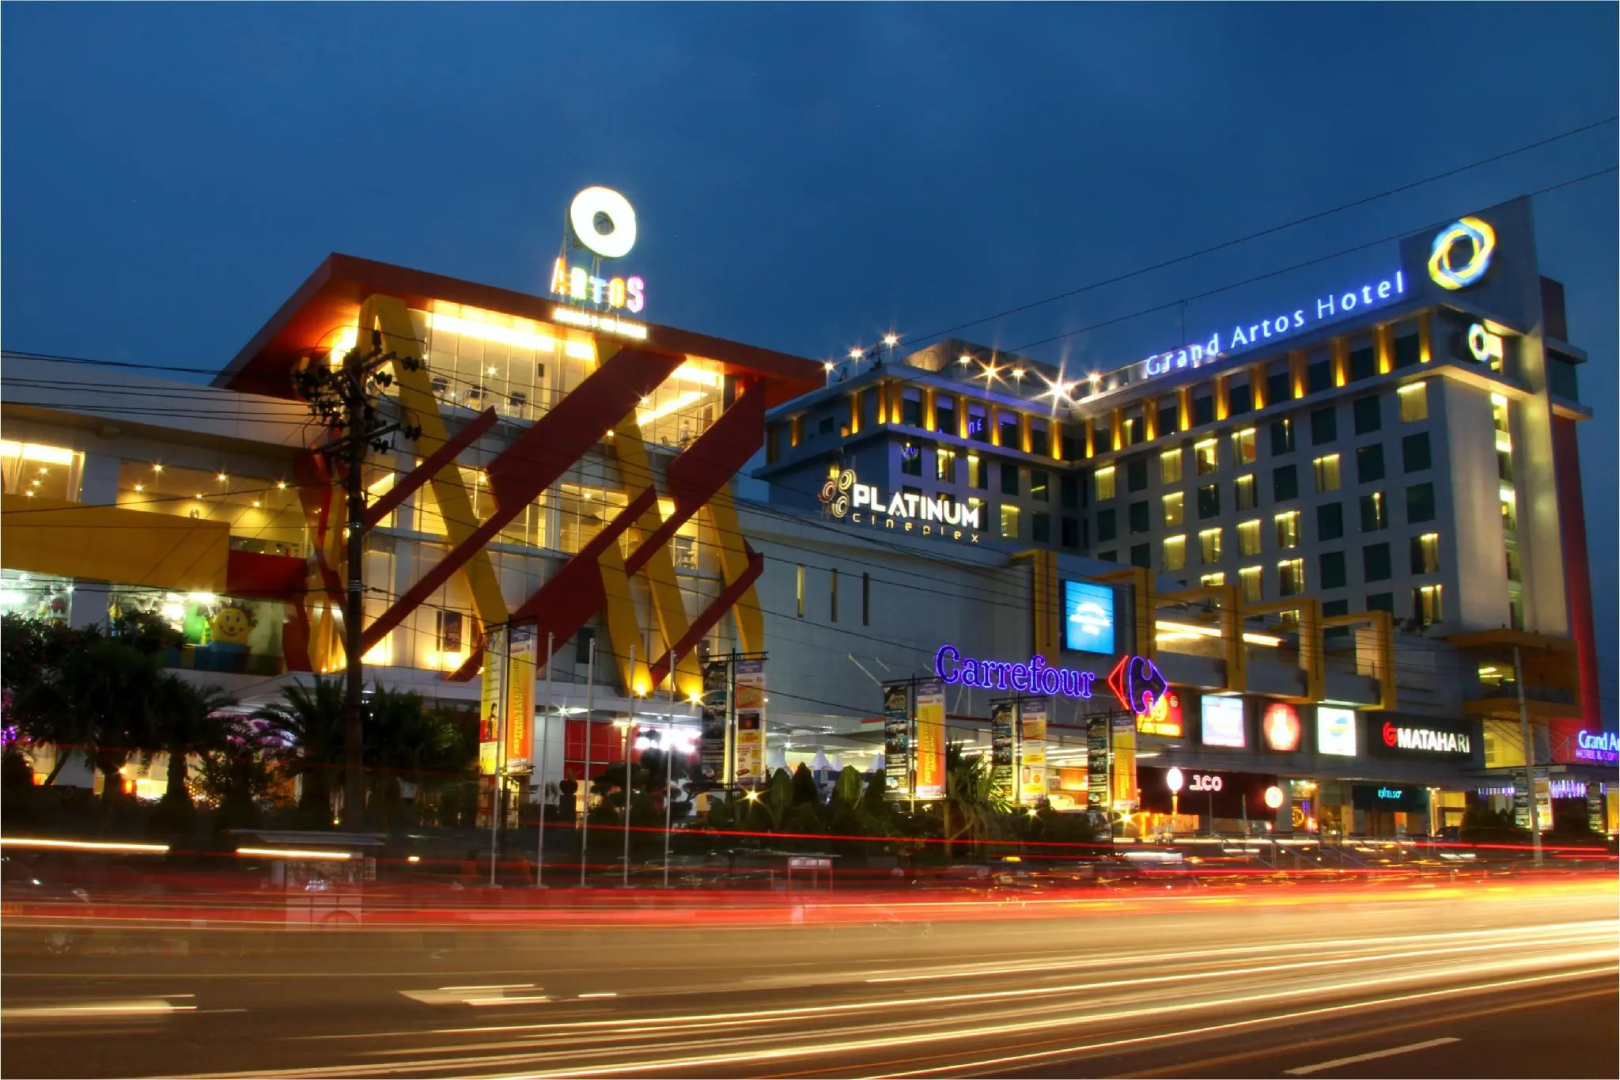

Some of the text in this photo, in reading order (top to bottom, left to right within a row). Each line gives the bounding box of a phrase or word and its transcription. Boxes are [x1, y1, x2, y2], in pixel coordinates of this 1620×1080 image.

[551, 256, 644, 313] ARTOS
[1145, 270, 1403, 375] Grand Artos Hotel
[852, 483, 979, 529] PLATINUM
[852, 513, 979, 543] cineplex
[935, 644, 1095, 698] Carrefour
[1397, 728, 1470, 753] MATAHARI
[1578, 730, 1608, 750] Grand
